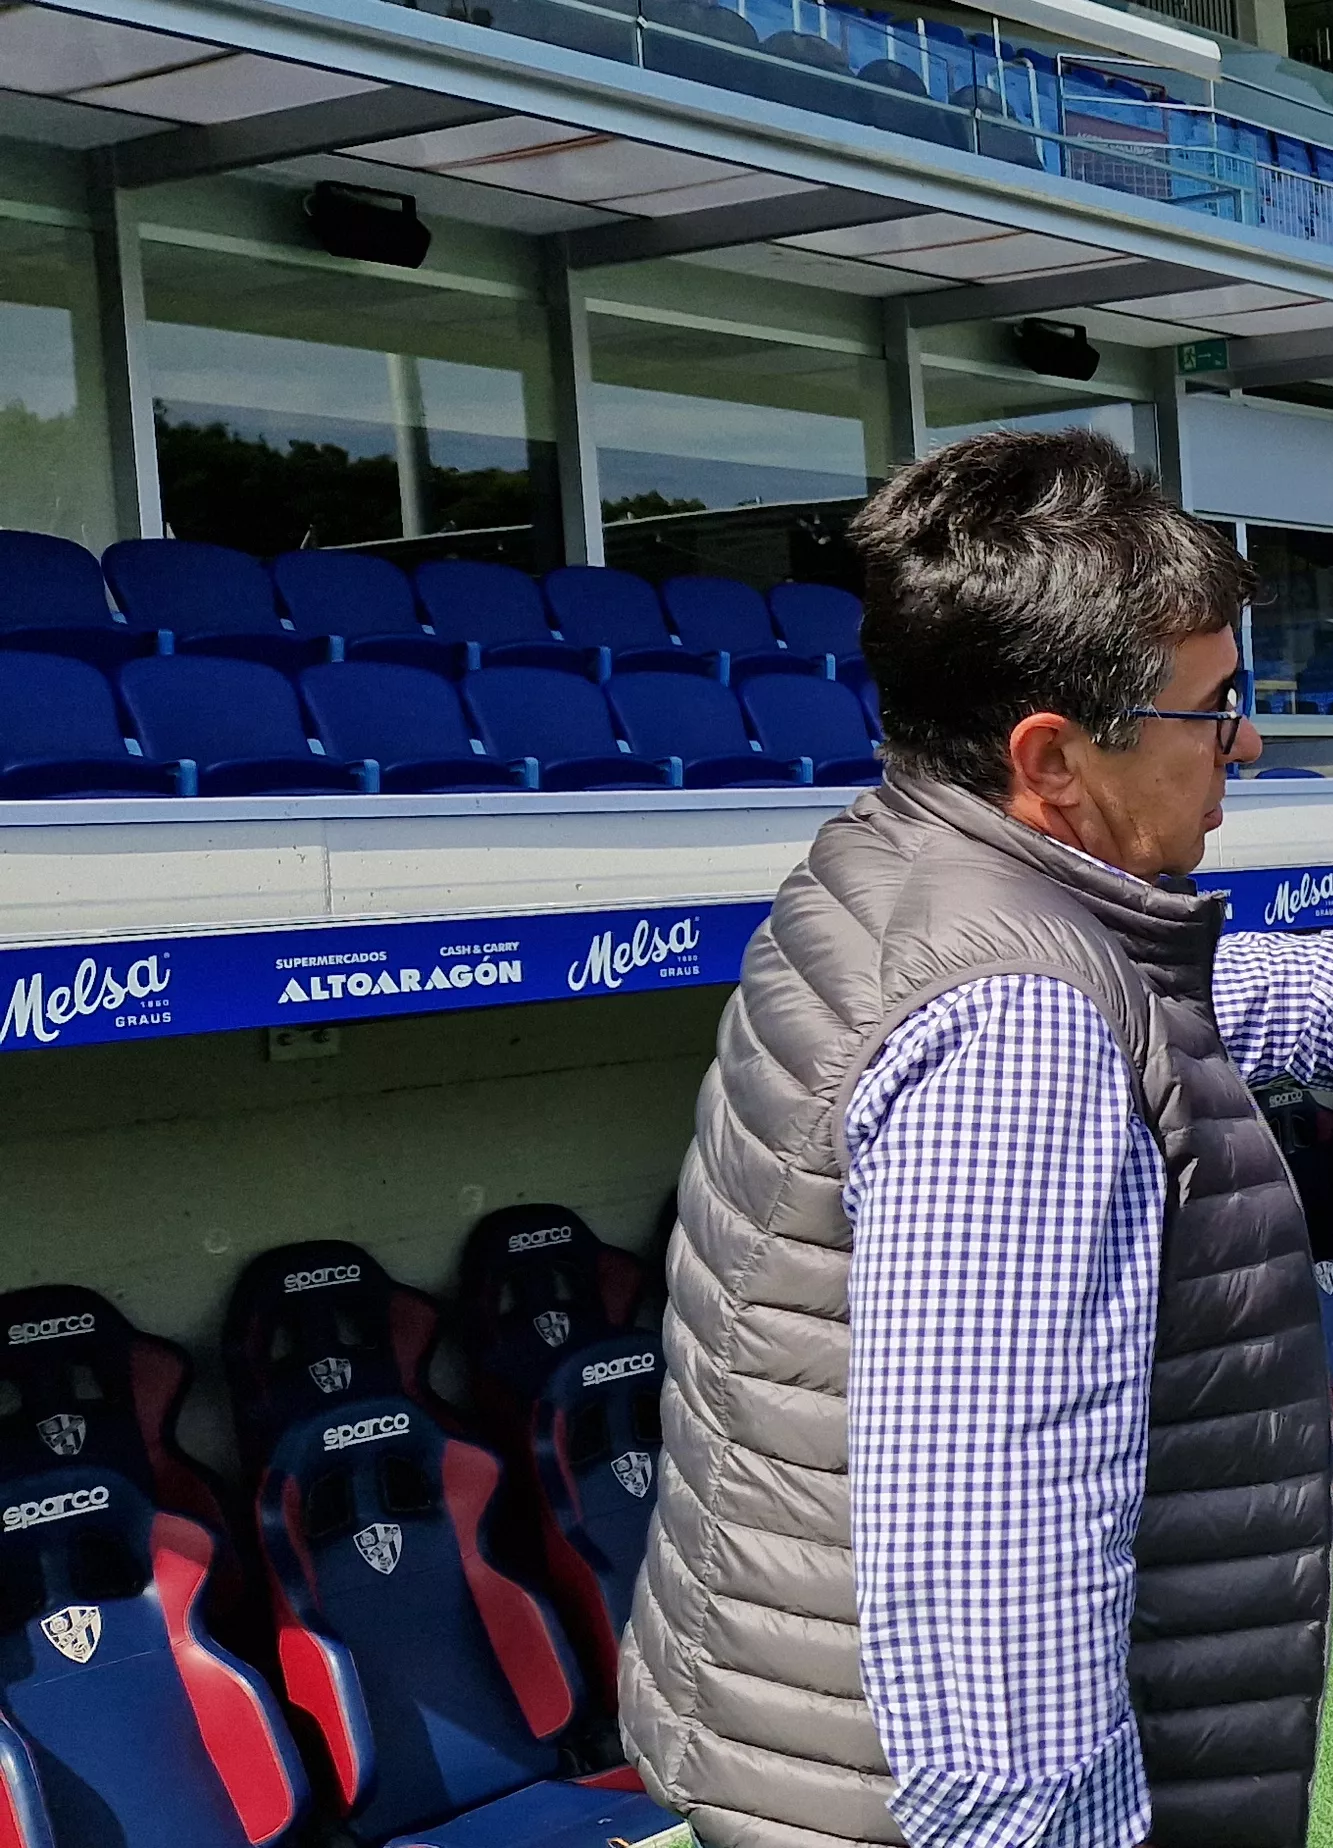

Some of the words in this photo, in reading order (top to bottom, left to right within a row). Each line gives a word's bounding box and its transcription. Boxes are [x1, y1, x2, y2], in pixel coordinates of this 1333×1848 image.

[275, 951, 387, 969] SUPERMERCADOS
[439, 945, 470, 957] CASH
[472, 944, 480, 954] &
[483, 941, 520, 954] CARRY
[567, 918, 700, 992] Melsa
[277, 955, 522, 1004] ALTOARAGÓN
[660, 966, 700, 978] GRAUS
[0, 955, 171, 1045] Melsa
[115, 1011, 172, 1028] GRAUS
[508, 1226, 572, 1252] sparco
[284, 1264, 361, 1293] sparco
[7, 1313, 95, 1345] sparco
[582, 1352, 655, 1386] sparco
[323, 1413, 410, 1451] sparco
[3, 1486, 109, 1532] sparco
